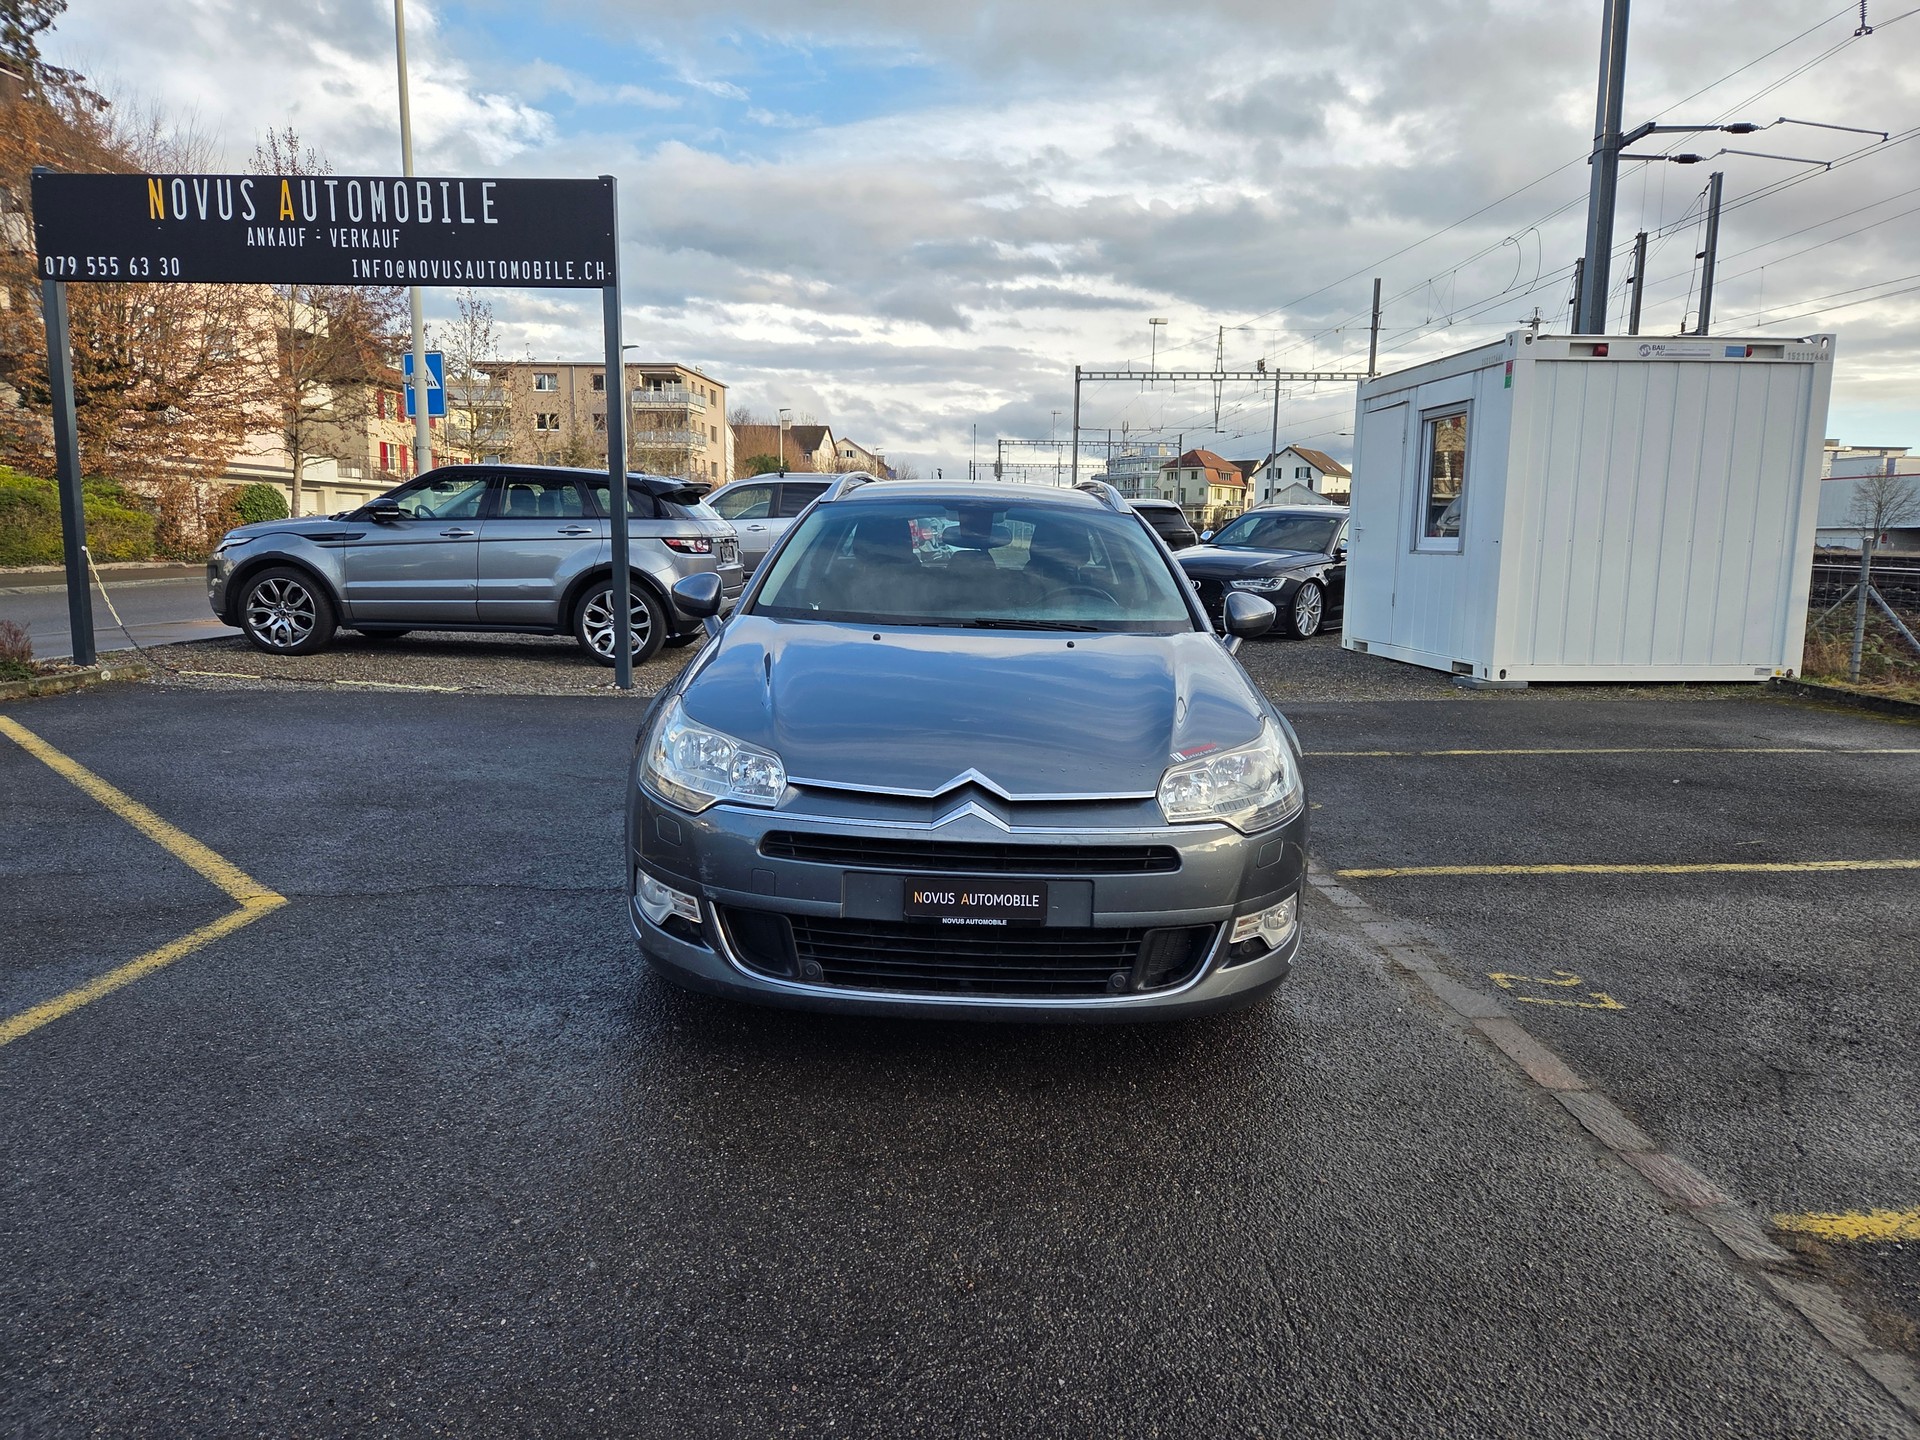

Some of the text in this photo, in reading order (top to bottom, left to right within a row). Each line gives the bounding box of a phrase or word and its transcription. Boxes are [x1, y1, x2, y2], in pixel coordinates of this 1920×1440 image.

[147, 178, 499, 224] NOVUS AUTOMOBILE
[247, 227, 306, 247] ANKAUF
[329, 228, 400, 248] VERKAUF
[44, 256, 180, 276] 079 555 63 30
[351, 258, 605, 281] INFO@NOVUSAUTOMOBILE.CH
[914, 892, 1039, 906] NOVUS AUTOMOBILE
